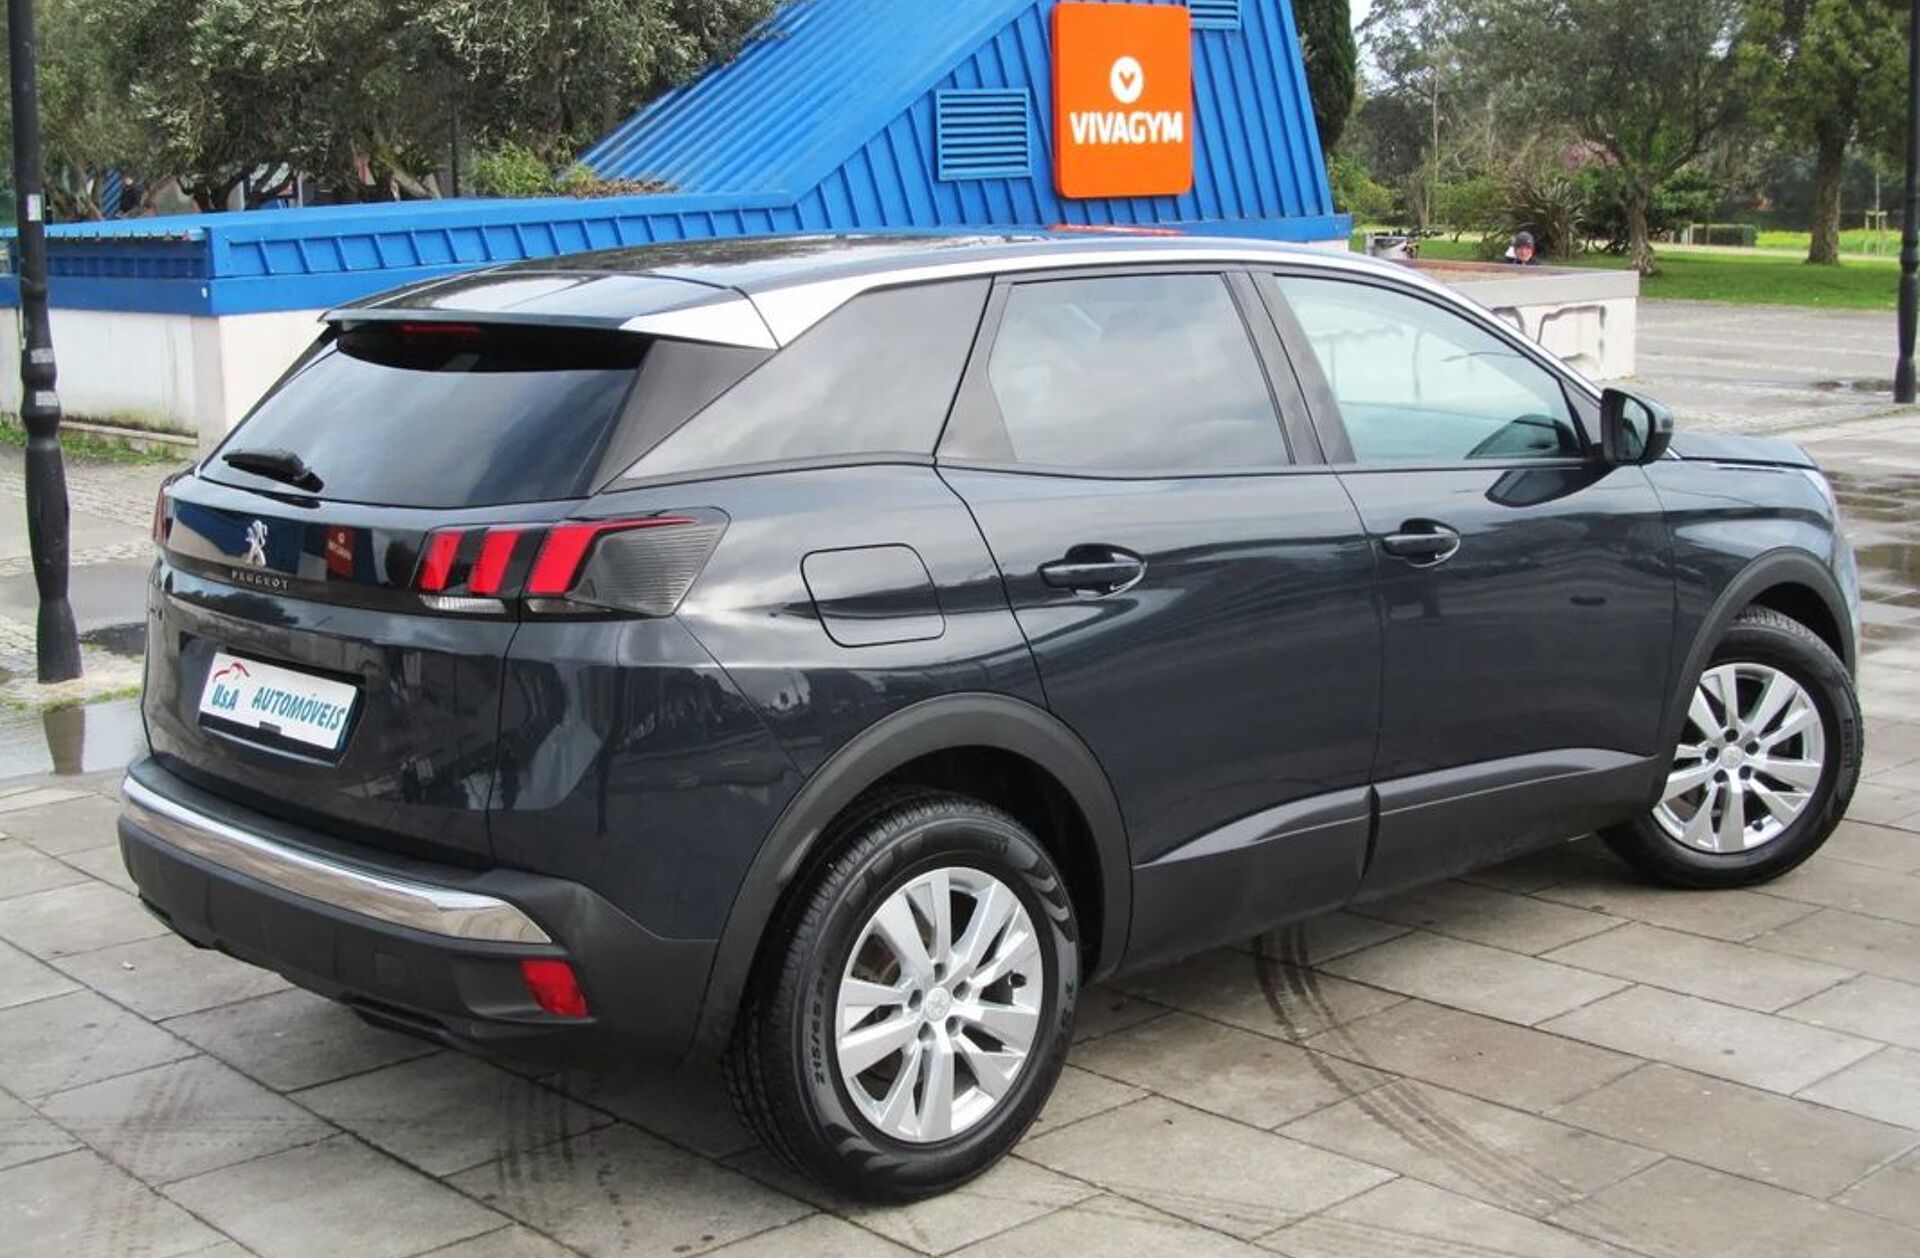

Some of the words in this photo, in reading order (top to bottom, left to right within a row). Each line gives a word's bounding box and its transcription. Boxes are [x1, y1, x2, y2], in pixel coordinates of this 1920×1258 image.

[1070, 111, 1183, 144] VIVAGYM
[231, 570, 289, 590] PEUGEOT
[252, 686, 346, 731] AUTOMÓVEIS
